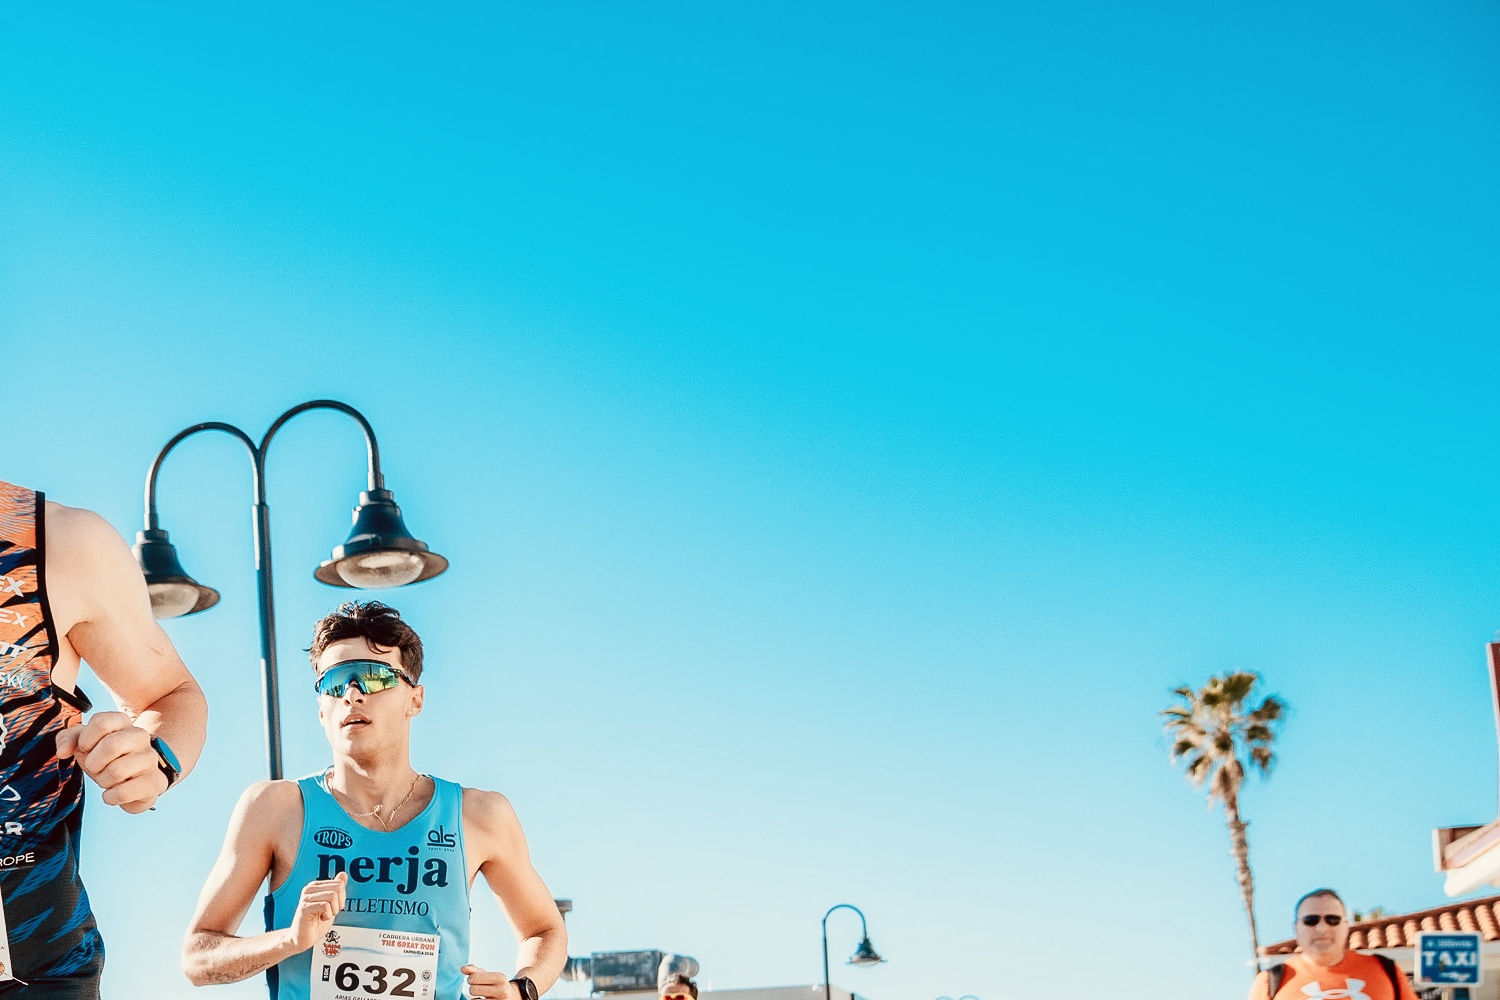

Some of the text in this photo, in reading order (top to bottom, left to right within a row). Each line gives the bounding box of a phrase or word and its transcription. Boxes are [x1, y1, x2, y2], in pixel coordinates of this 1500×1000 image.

[316, 830, 351, 847] TROPS
[427, 825, 456, 848] als
[316, 846, 448, 894] nerja
[340, 898, 429, 917] TLETISMO
[383, 933, 410, 941] CARRERA
[397, 940, 419, 949] GREAT
[420, 942, 435, 951] RUN
[1423, 951, 1477, 967] TAXI
[334, 962, 416, 998] 632
